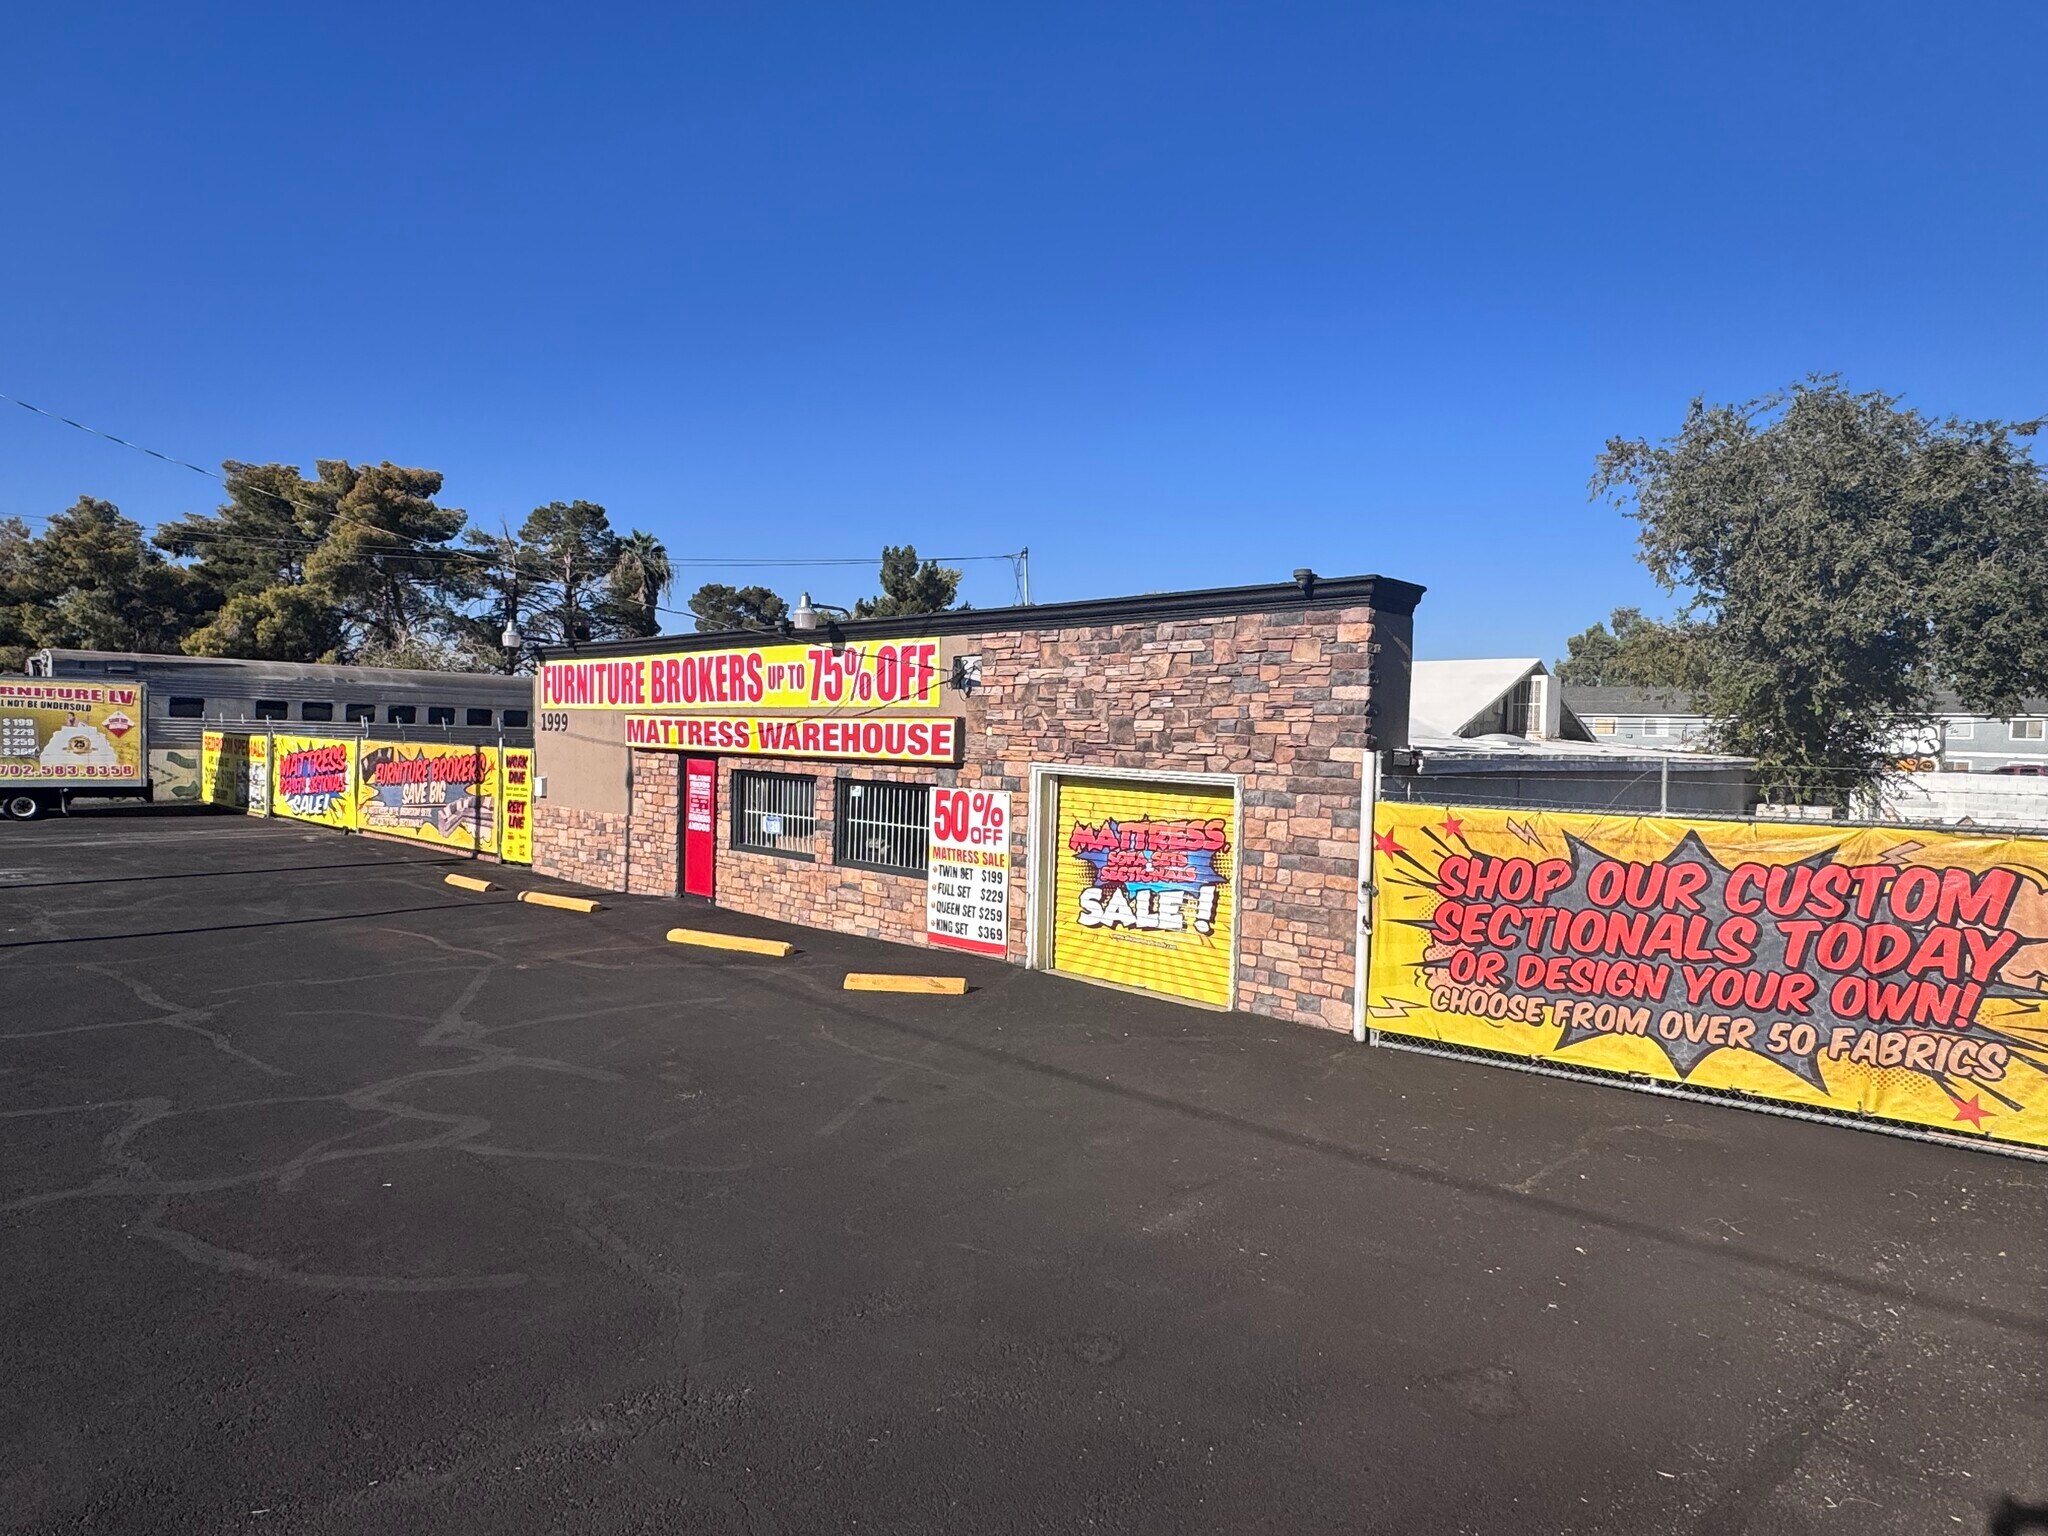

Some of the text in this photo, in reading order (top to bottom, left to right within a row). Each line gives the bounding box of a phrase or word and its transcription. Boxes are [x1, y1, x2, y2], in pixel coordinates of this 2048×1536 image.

[544, 645, 936, 705] FURNITURE BROKERS UP TO 75% OFF
[7, 699, 25, 709] NOT
[27, 701, 38, 710] BE
[40, 702, 92, 712] UNDERSOLD
[108, 690, 135, 705] LV
[541, 713, 568, 732] 1999
[627, 719, 952, 755] MATTRESS WAREHOUSE
[375, 752, 487, 785] FURNITURE BROKERS
[402, 781, 446, 804] SAVE BIG
[291, 793, 330, 816] SALE!
[934, 789, 1004, 846] 50% OFF
[933, 846, 1005, 868] MATTRESS SALE
[1107, 851, 1148, 866] SOFA
[1151, 851, 1188, 867] SETS
[938, 865, 957, 879] TWIN
[981, 870, 1003, 884] $199
[937, 883, 1003, 903] FULL SET $229
[1435, 855, 2018, 927] SHOP OUR CUSTOM
[936, 901, 1003, 923] QUEEN SET $259
[1077, 884, 1216, 935] SALE!
[936, 918, 1003, 941] KING SET $369
[1431, 900, 2019, 984] SECTIONALS TODAY
[1449, 950, 1982, 1029] OR DESIGN YOUR OWN!
[1430, 985, 2012, 1083] CHOOSE FROM OVER 50 FABRICS
